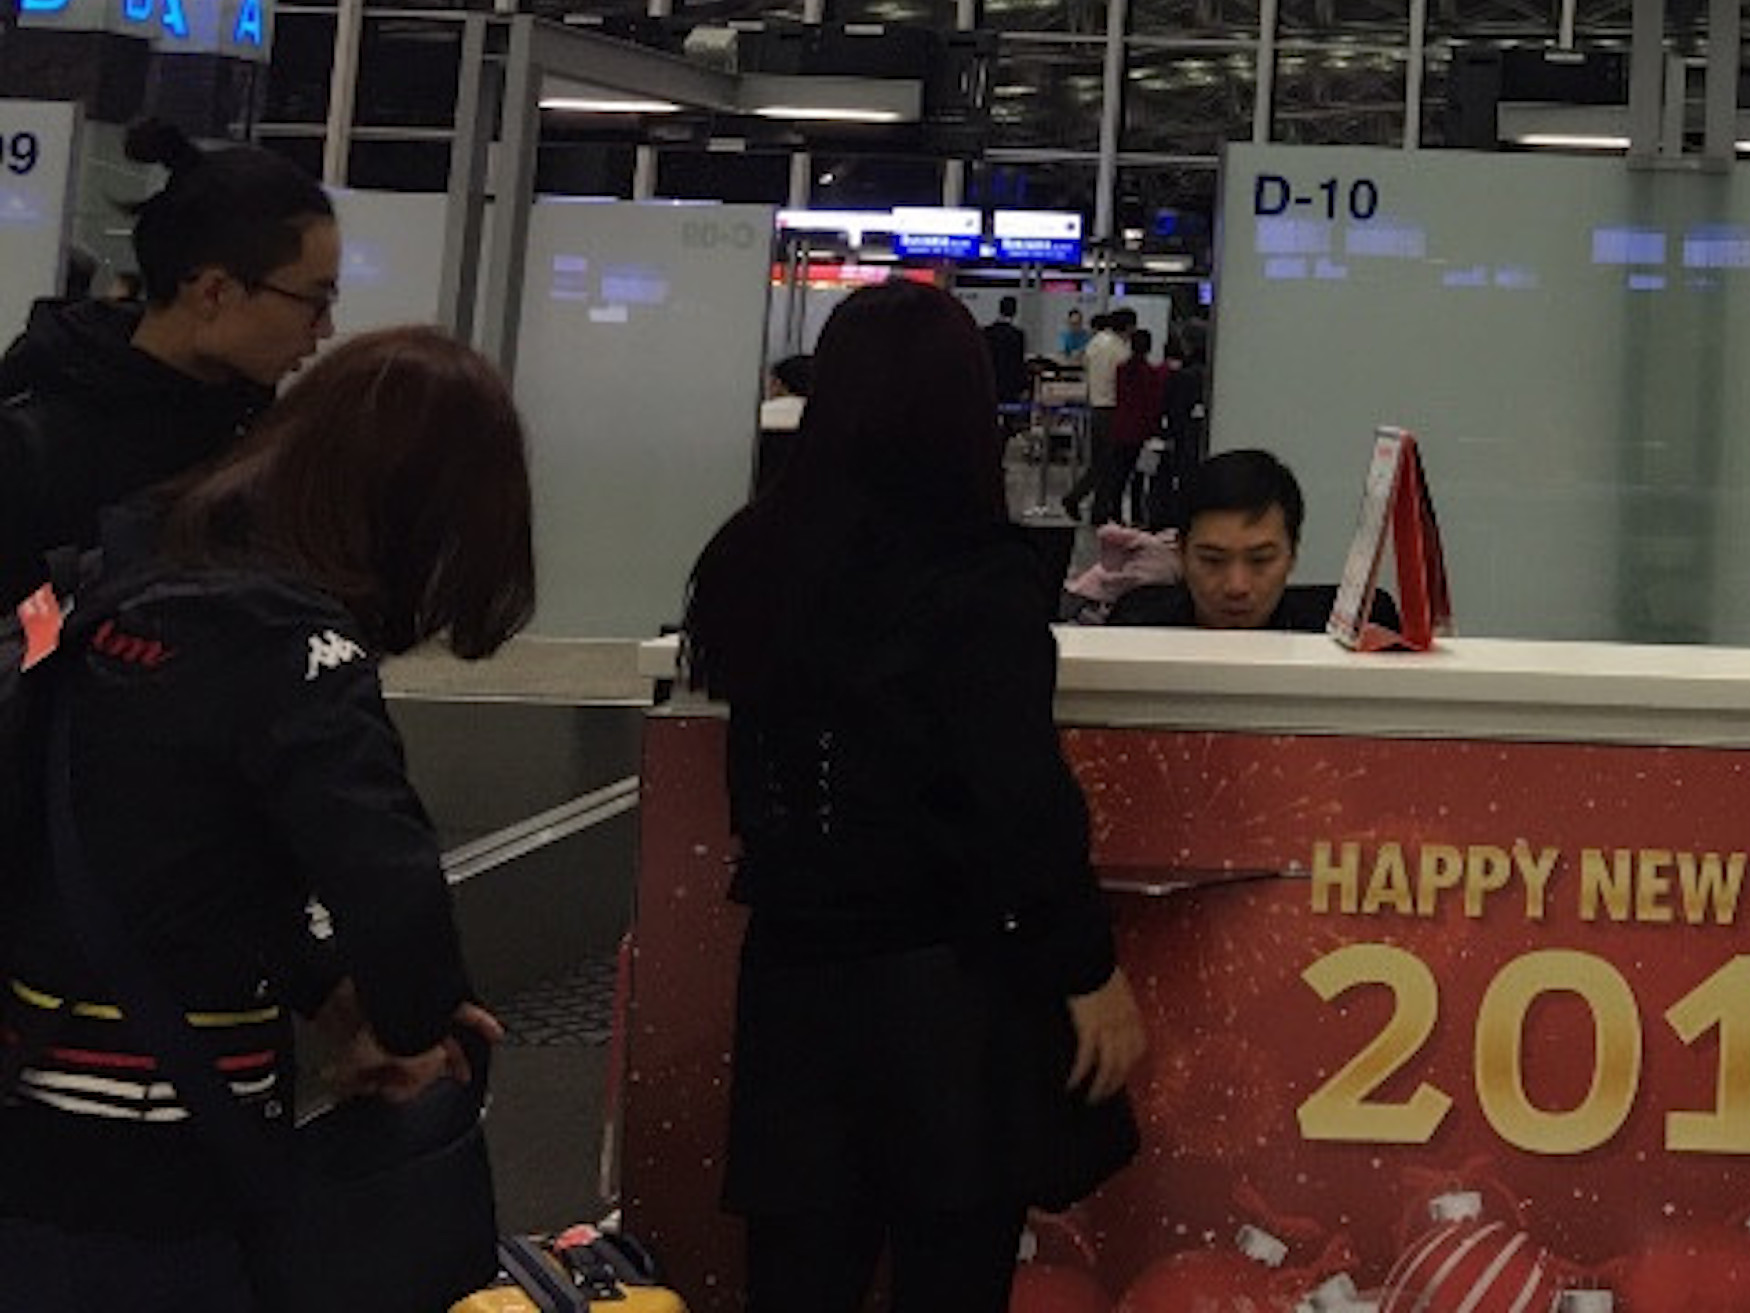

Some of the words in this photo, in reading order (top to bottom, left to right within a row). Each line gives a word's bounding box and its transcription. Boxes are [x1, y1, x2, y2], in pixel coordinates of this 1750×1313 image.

[1255, 175, 1378, 219] D-10
[1311, 841, 1560, 923] HAPPY
[1578, 848, 1747, 926] NEW
